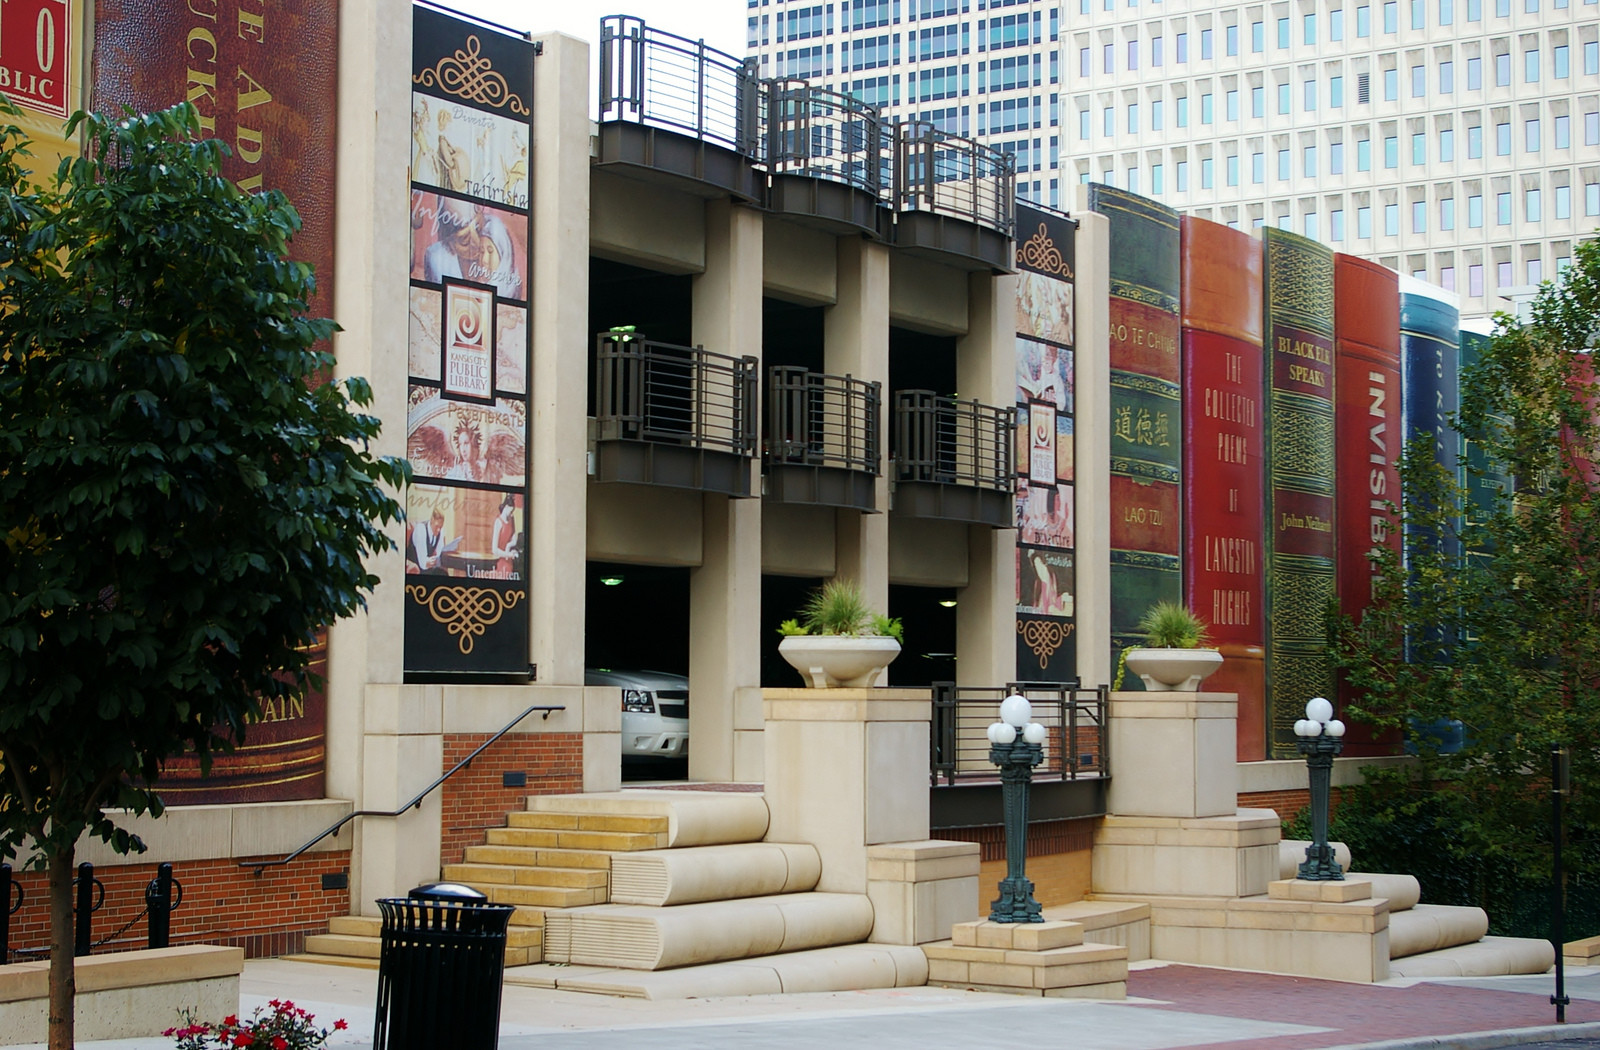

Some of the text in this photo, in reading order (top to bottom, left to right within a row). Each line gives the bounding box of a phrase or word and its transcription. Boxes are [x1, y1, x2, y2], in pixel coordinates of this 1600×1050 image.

[1132, 327, 1143, 345] TE
[1278, 336, 1315, 360] BLACK
[450, 352, 487, 365] KANSAS CITY
[450, 361, 487, 379] PUBLIC
[1289, 364, 1325, 388] SPEAKS
[450, 374, 487, 390] LIBRARY
[1124, 507, 1163, 526] LAO TZU
[1280, 513, 1304, 531] John
[1205, 535, 1255, 575] LANGSTON
[1213, 589, 1250, 625] HUGHES
